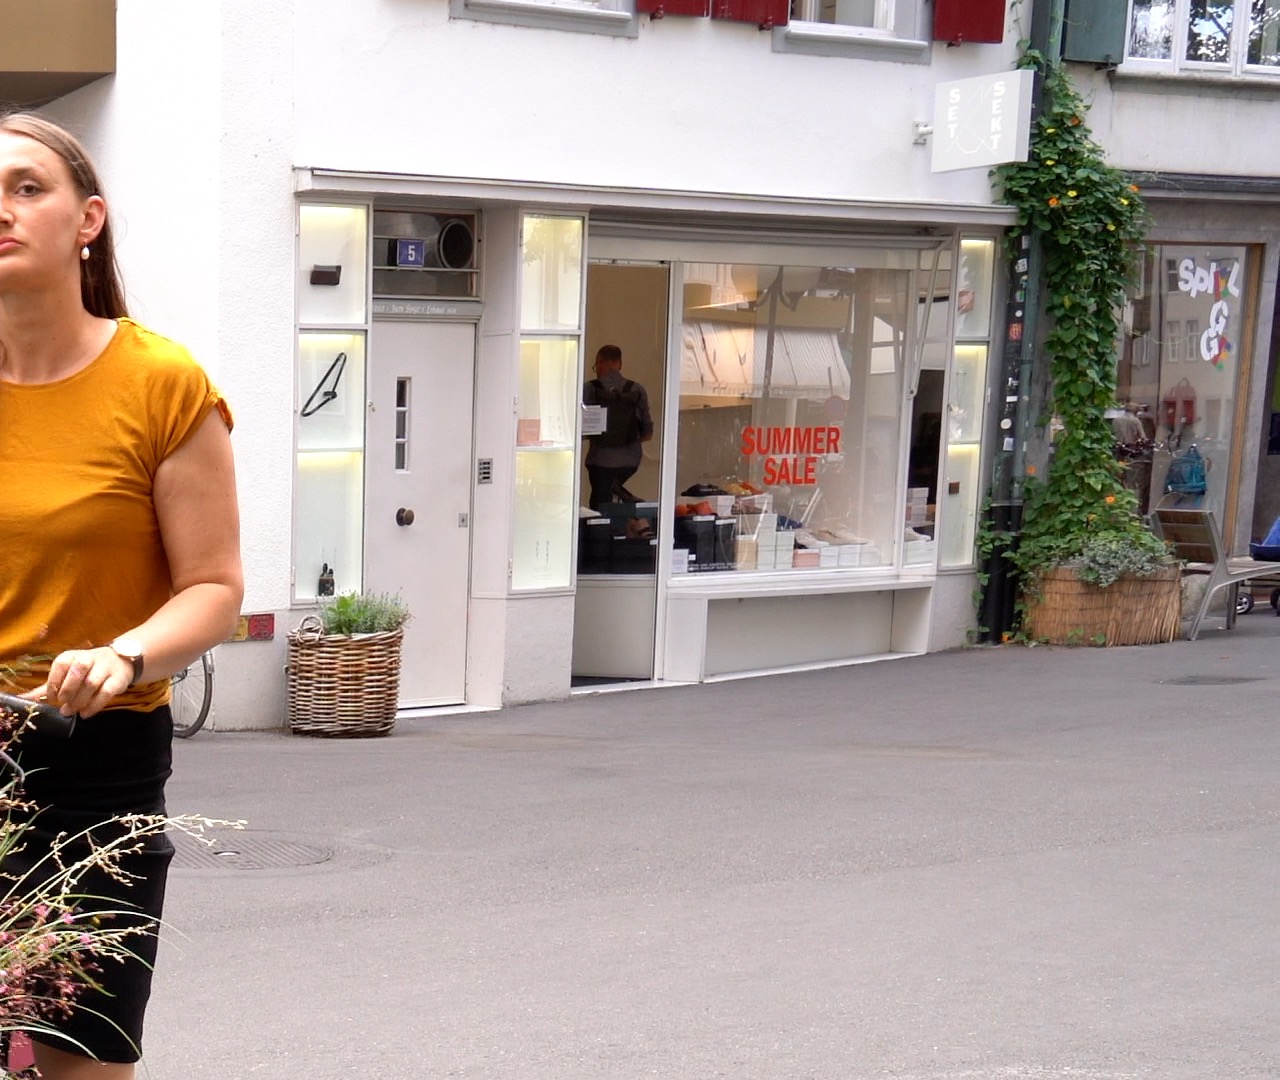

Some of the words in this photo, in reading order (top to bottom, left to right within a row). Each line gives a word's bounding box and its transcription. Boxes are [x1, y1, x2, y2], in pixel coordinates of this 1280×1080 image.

[947, 87, 961, 139] SET
[989, 80, 1006, 151] SEKT
[407, 244, 416, 261] 5
[741, 426, 841, 455] SUMMER
[763, 456, 817, 486] SALE
